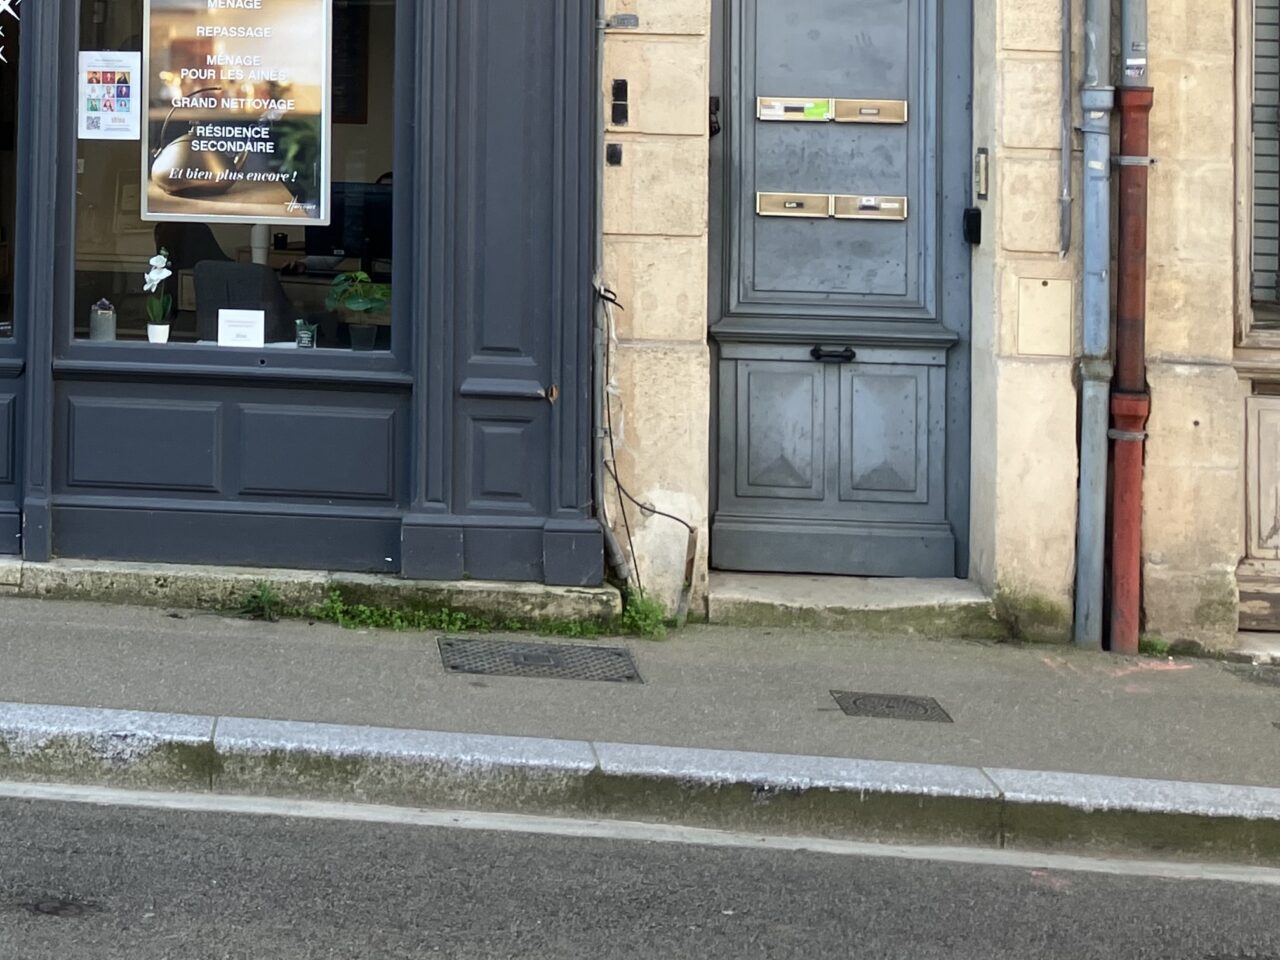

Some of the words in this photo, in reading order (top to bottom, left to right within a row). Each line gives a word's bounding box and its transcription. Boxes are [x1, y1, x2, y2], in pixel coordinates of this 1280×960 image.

[196, 25, 272, 38] REPASSAGE
[180, 68, 216, 80] POUR
[220, 69, 244, 80] LES
[171, 97, 217, 109] GRAND
[221, 98, 296, 110] NETTOYAGE
[196, 123, 270, 139] RÉSIDENCE
[191, 140, 275, 153] SECONDAIRE
[168, 167, 183, 179] Et
[185, 168, 213, 180] bien
[215, 168, 244, 183] plus
[246, 172, 289, 182] encore
